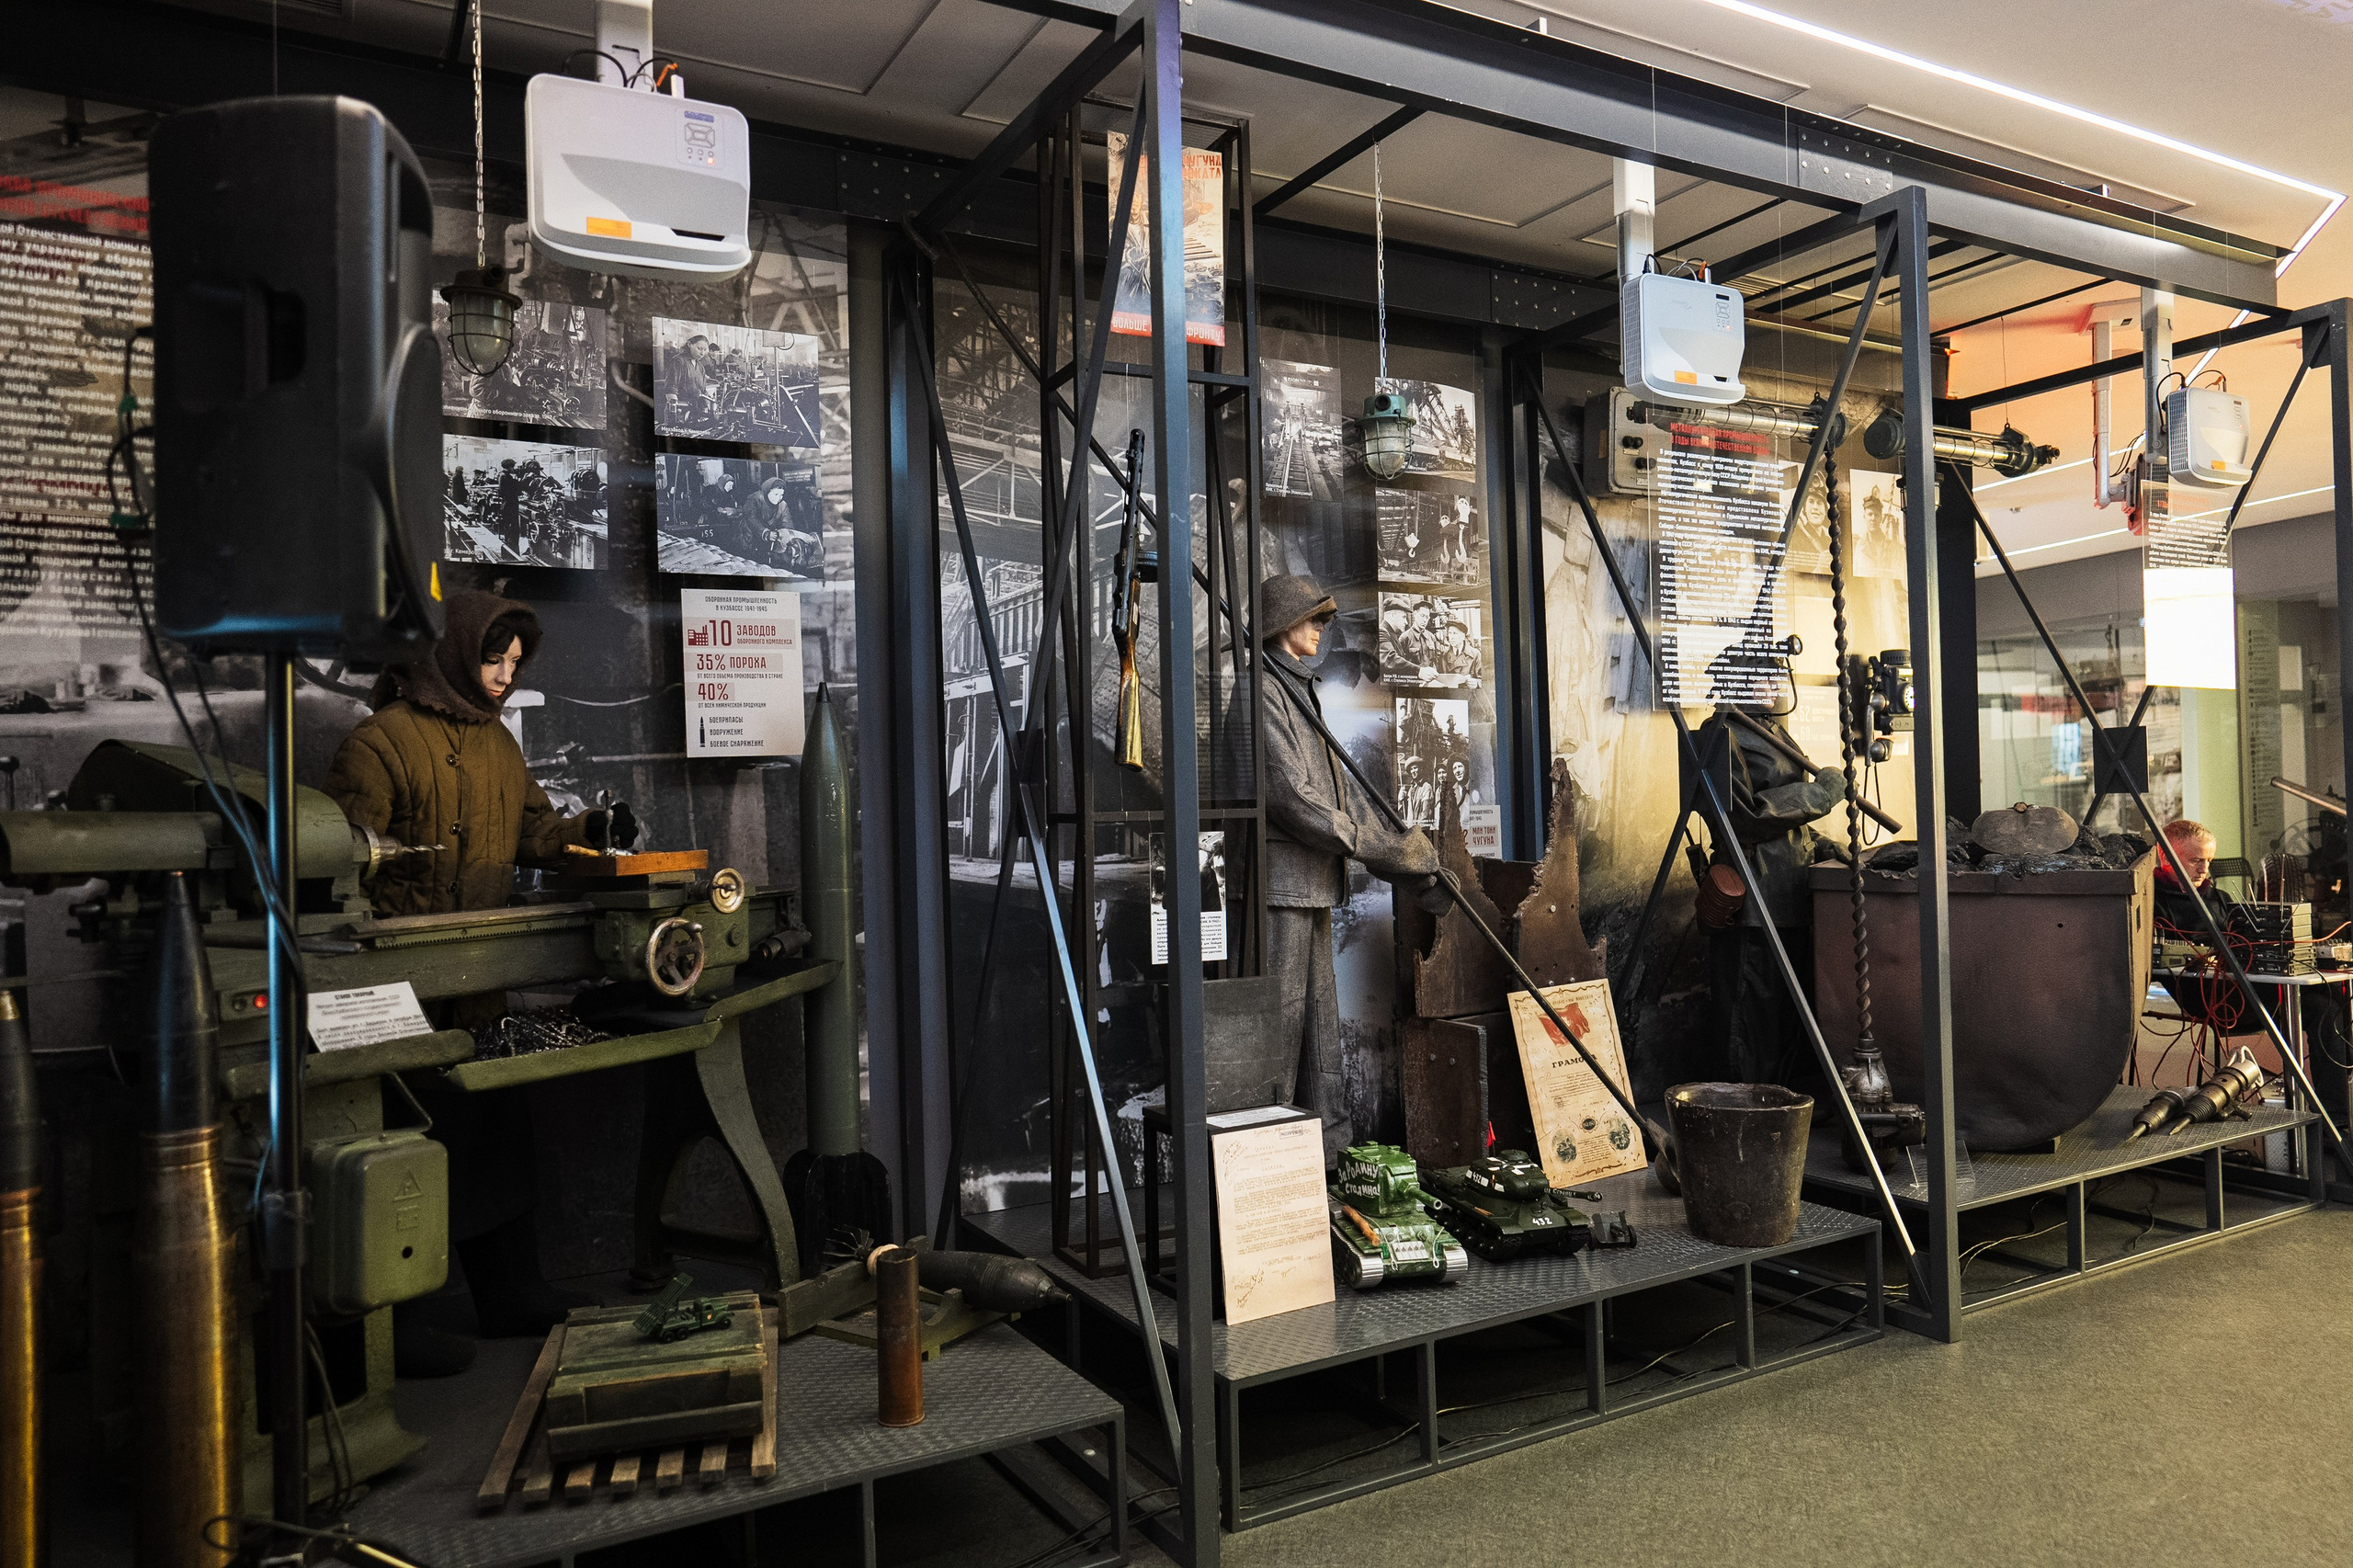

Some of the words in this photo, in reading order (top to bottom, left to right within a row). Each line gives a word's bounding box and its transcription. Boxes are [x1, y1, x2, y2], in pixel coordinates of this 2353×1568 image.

[1676, 437, 1689, 446] ГОДЫ
[1711, 441, 1753, 454] ОТЕЧЕСТВЕННОЙ
[1657, 498, 1695, 506] Отечественной
[1726, 506, 1760, 515] представлена
[16, 539, 99, 552] Отечественной
[31, 555, 93, 568] продукции
[98, 558, 128, 569] были
[709, 619, 733, 647] 10
[736, 625, 776, 636] ЗАВОДОВ
[697, 653, 726, 671] 35%
[730, 656, 767, 669] ПОРОХА
[698, 683, 729, 700] 40%
[1800, 705, 1811, 722] 52
[1800, 725, 1811, 741] 60
[730, 739, 764, 747] СНАРЯЖЕНИЕ
[1472, 826, 1483, 835] МЛН
[1483, 826, 1496, 835] ТОНН
[1472, 835, 1495, 846] ЧУГУНА
[1552, 1054, 1597, 1069] ГРАМОА
[1338, 1168, 1347, 1184] За
[1532, 1217, 1553, 1226] 432
